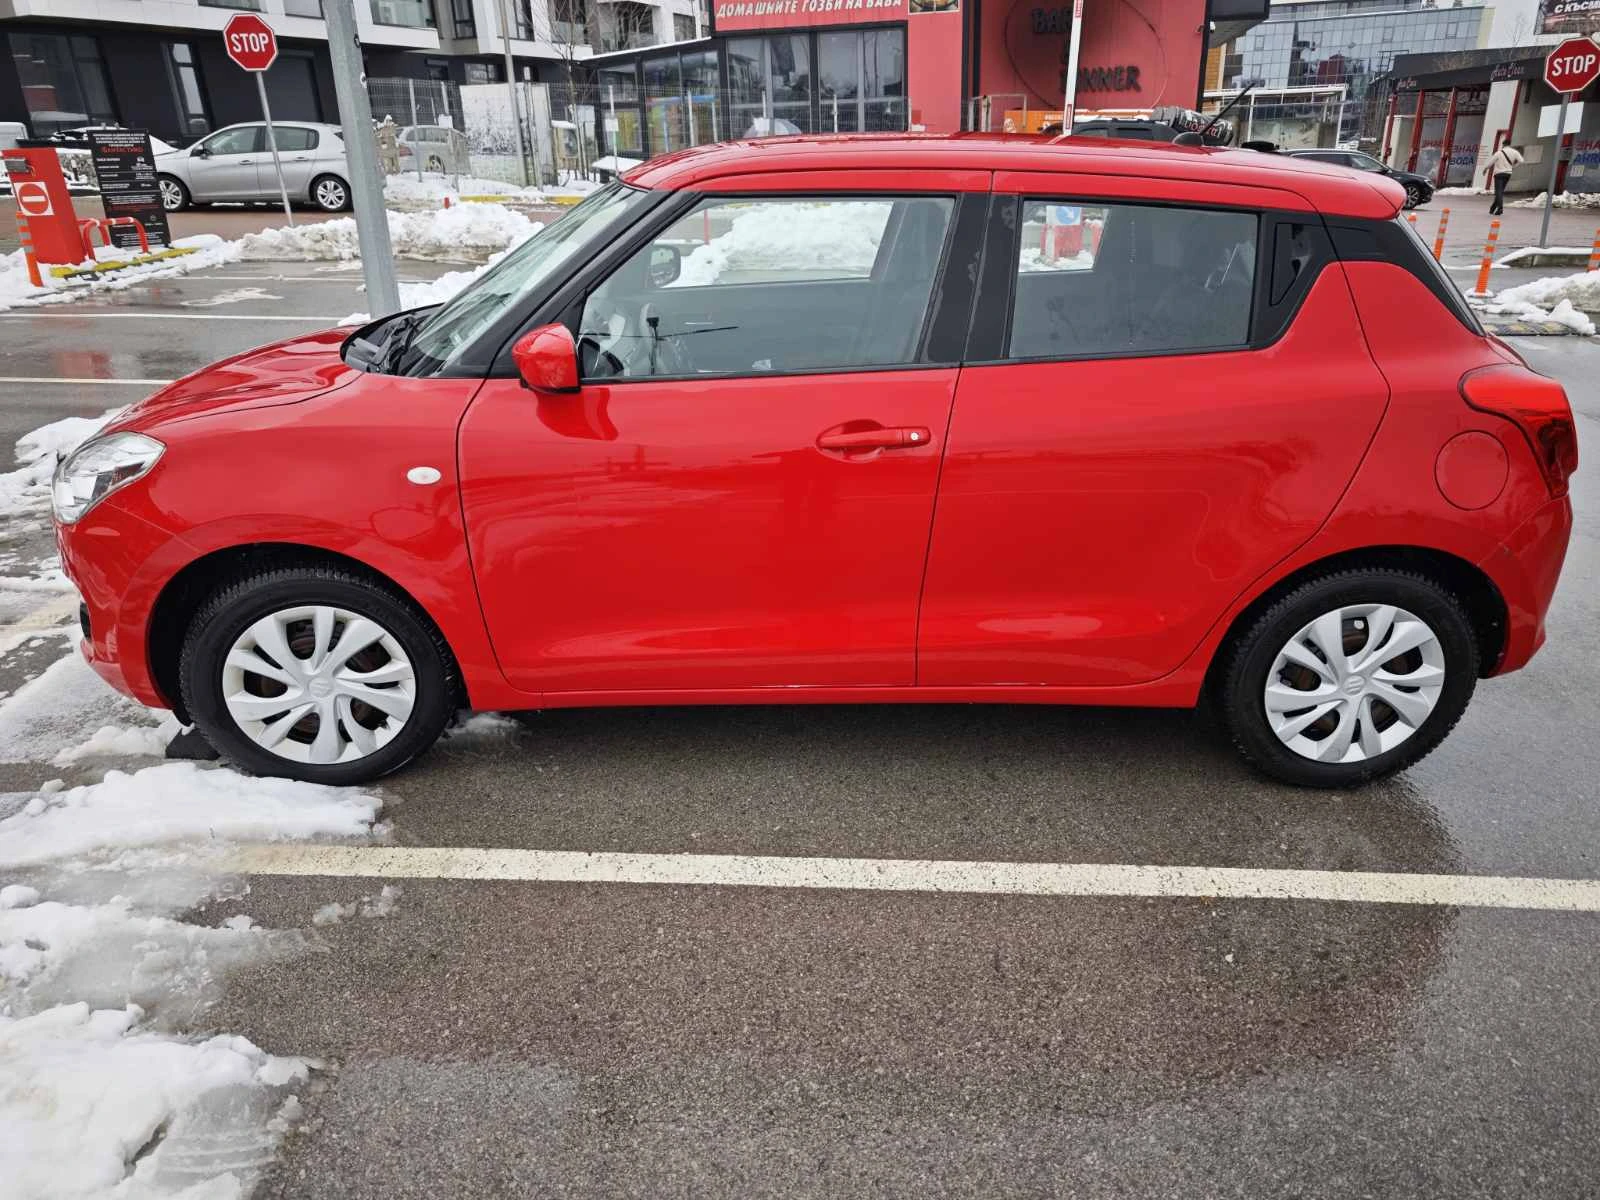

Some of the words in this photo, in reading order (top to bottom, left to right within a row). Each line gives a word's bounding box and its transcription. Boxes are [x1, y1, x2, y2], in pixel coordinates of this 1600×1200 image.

[716, 1, 798, 18] ДОМАШНИТЕ
[802, 0, 842, 12] ГОЗБИ
[845, 0, 863, 9] НА
[230, 33, 269, 53] STOP
[1551, 54, 1596, 77] STOP
